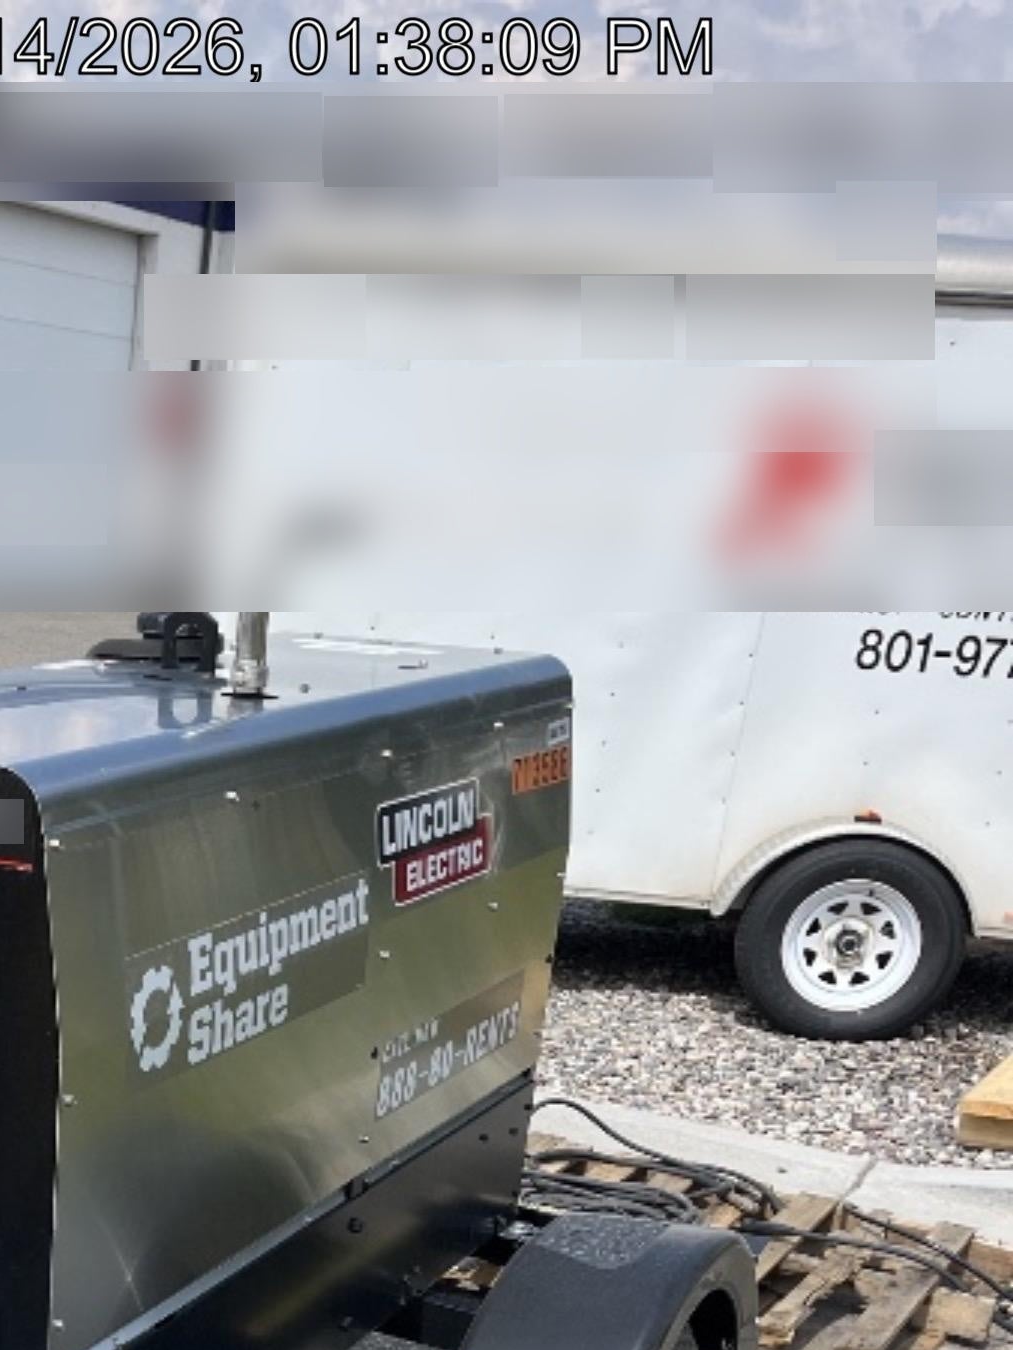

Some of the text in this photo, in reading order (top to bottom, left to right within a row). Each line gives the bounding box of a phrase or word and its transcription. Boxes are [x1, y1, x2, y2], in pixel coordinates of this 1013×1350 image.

[855, 628, 1013, 678] 801-97
[382, 788, 475, 855] LINCOLN
[406, 837, 484, 892] ELECTRIC
[188, 879, 369, 997] Equipment
[188, 983, 289, 1065] Share
[376, 1000, 520, 1118] 888-80-RENTS
